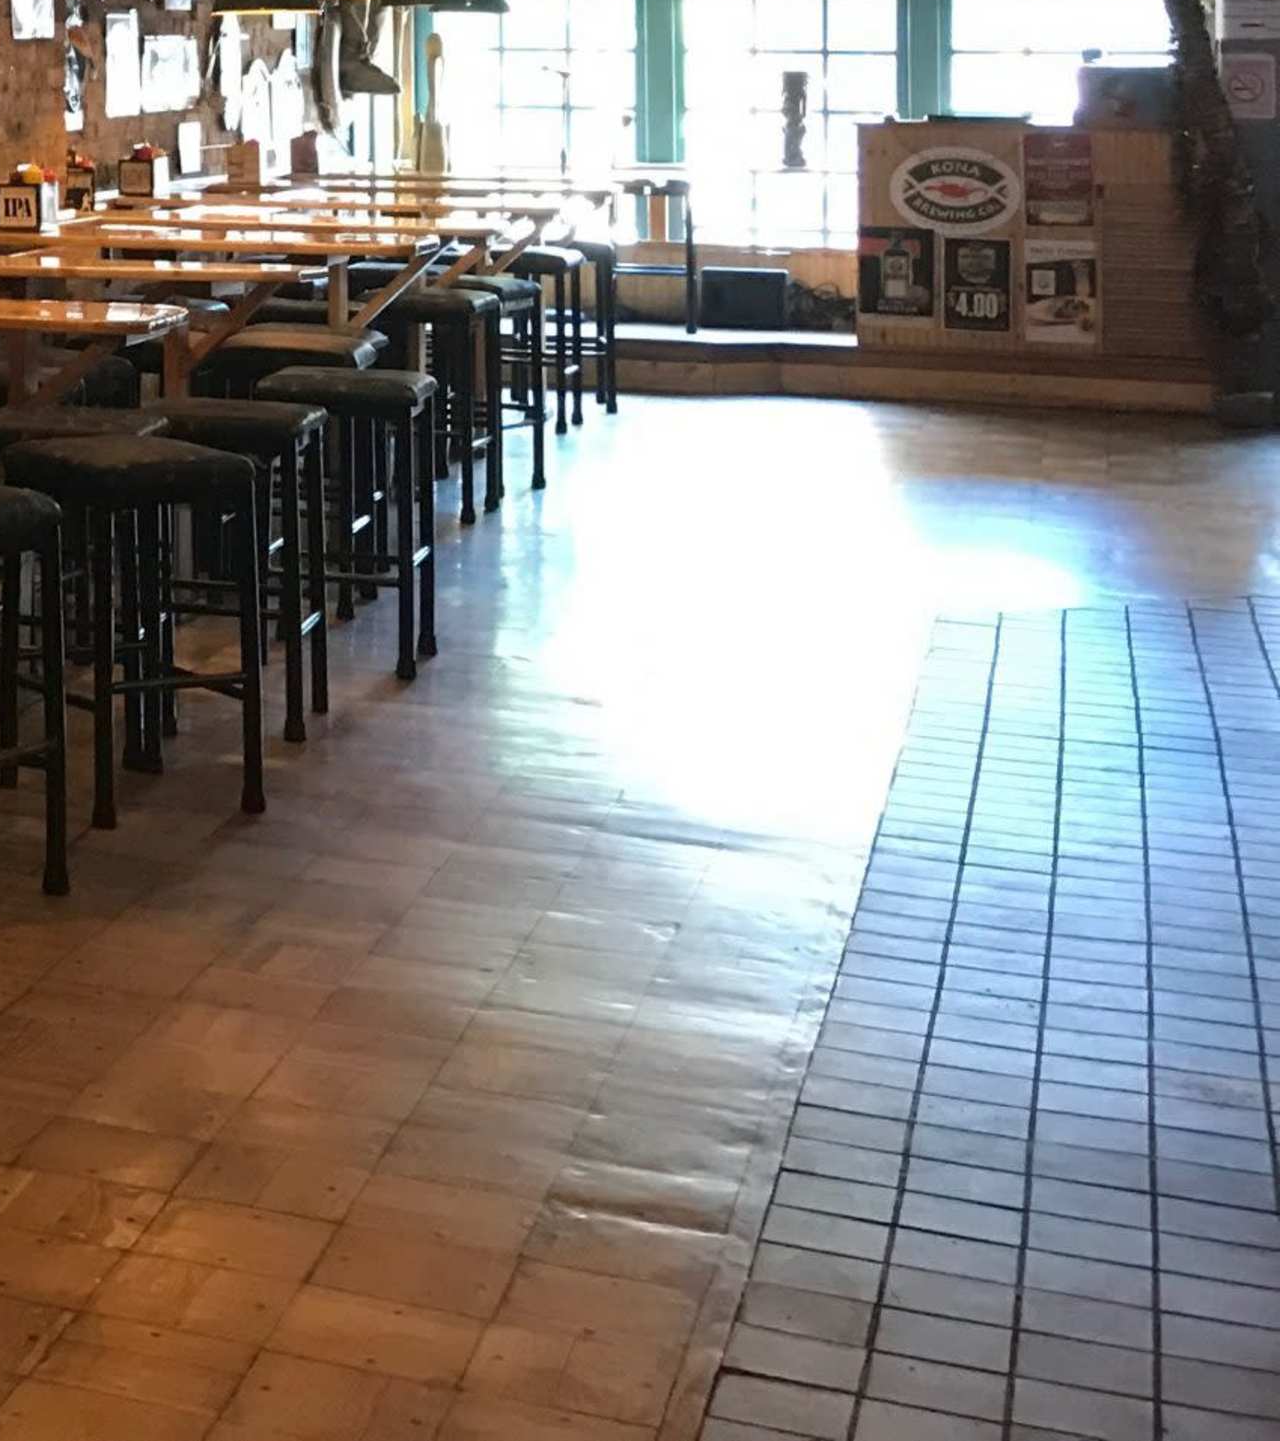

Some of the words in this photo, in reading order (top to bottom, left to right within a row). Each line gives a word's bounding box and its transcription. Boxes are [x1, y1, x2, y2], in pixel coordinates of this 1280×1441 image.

[930, 160, 982, 178] KONA
[3, 197, 34, 218] IPA
[912, 197, 976, 220] BREWING
